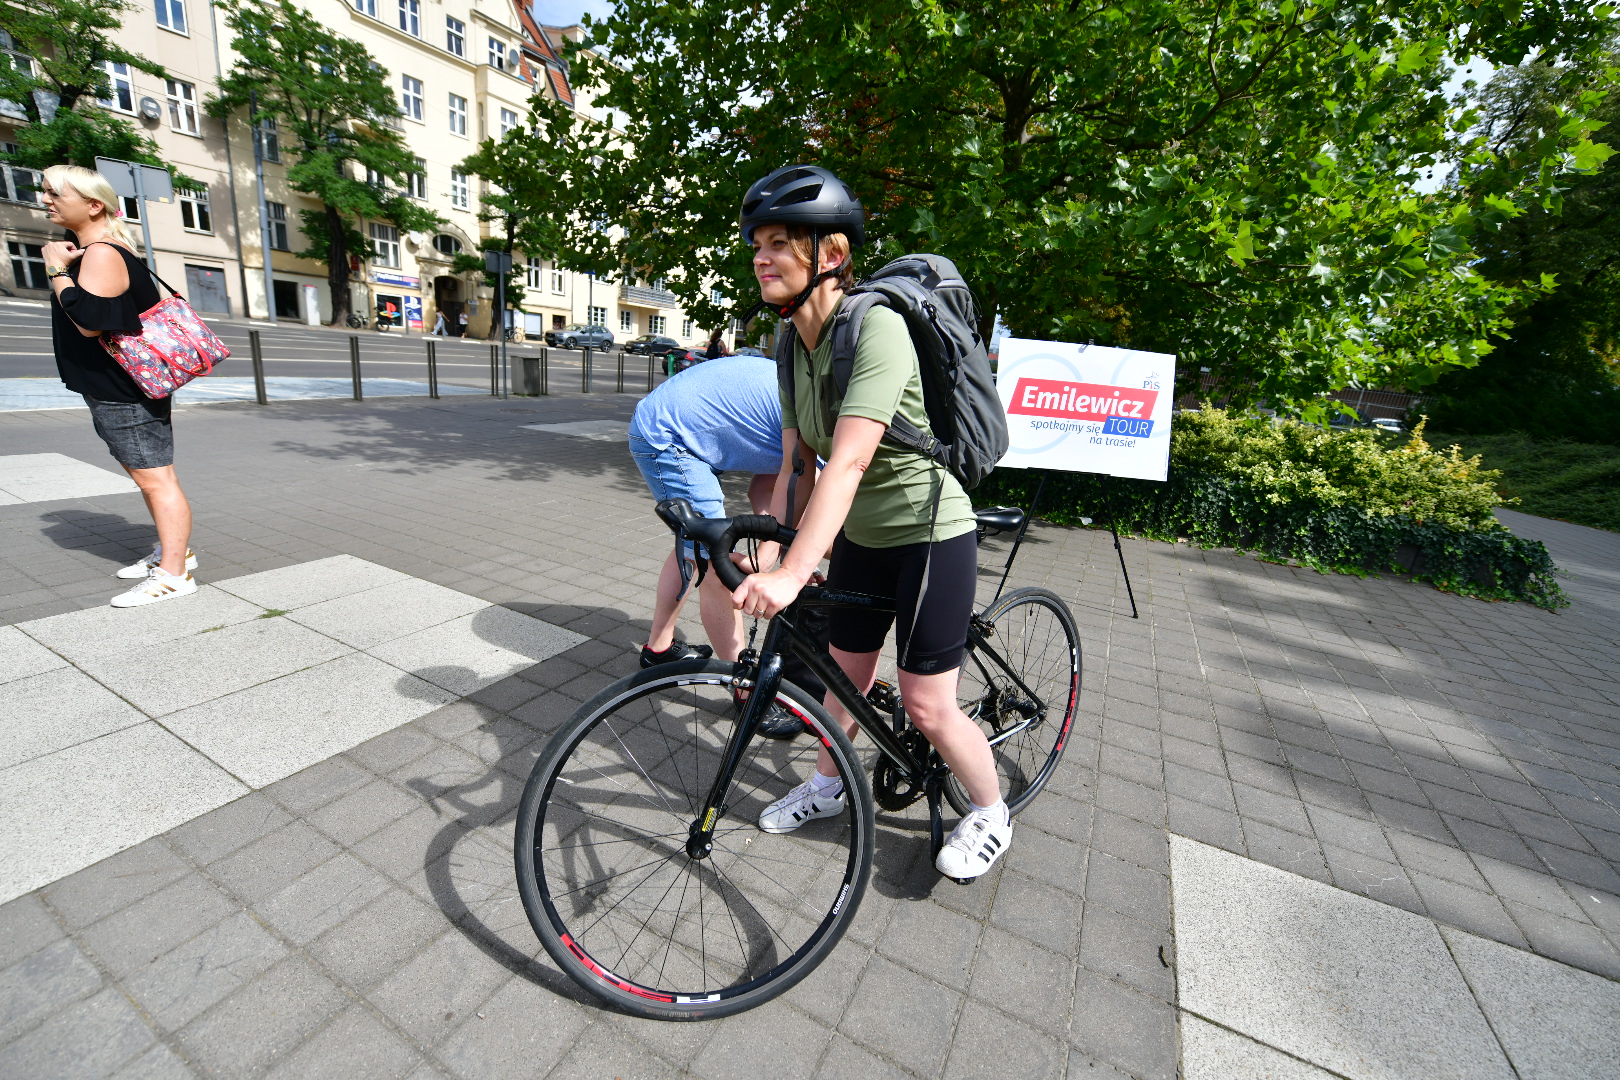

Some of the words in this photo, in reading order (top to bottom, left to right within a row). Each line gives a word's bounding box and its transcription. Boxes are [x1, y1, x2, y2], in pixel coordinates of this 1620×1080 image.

[1142, 380, 1161, 390] PiS
[1021, 385, 1145, 418] Emilewicz
[1030, 419, 1084, 435] spotkajmy
[1086, 422, 1101, 436] się
[1109, 418, 1150, 436] TOUR
[1089, 435, 1103, 446] na
[1105, 436, 1136, 448] trasie!
[917, 659, 938, 671] 4F
